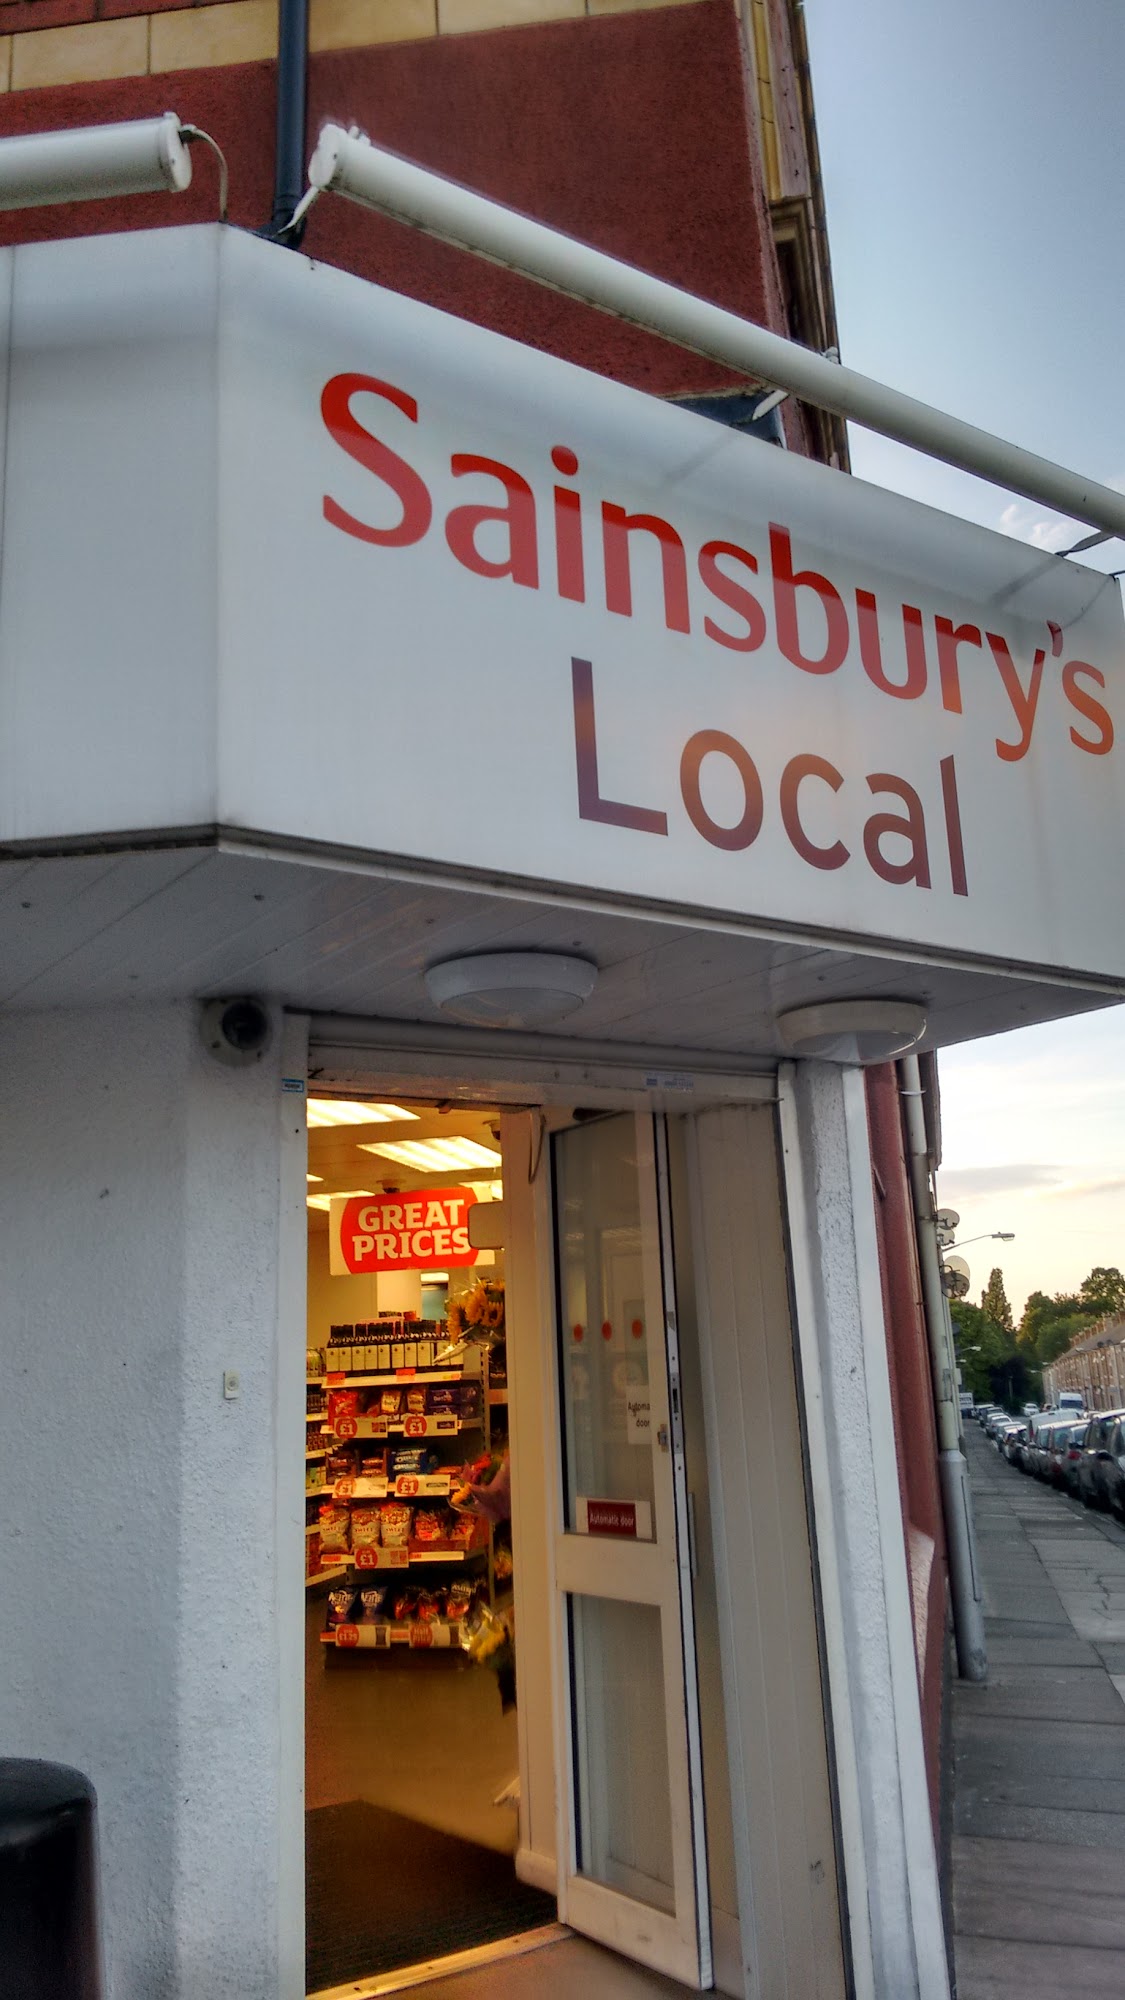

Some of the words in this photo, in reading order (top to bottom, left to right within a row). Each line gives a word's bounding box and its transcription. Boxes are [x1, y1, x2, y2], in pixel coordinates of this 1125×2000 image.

[320, 372, 1116, 762] Sainsbury's
[571, 656, 968, 897] Local
[358, 1199, 465, 1232] GREAT
[352, 1227, 471, 1262] PRICES
[628, 1402, 650, 1412] Automa
[340, 1423, 354, 1435] £1
[409, 1422, 424, 1434] £1
[338, 1483, 352, 1495] £1
[400, 1482, 415, 1494] £1
[590, 1513, 619, 1526] Automatic
[620, 1515, 634, 1527] door
[360, 1553, 374, 1566] £1
